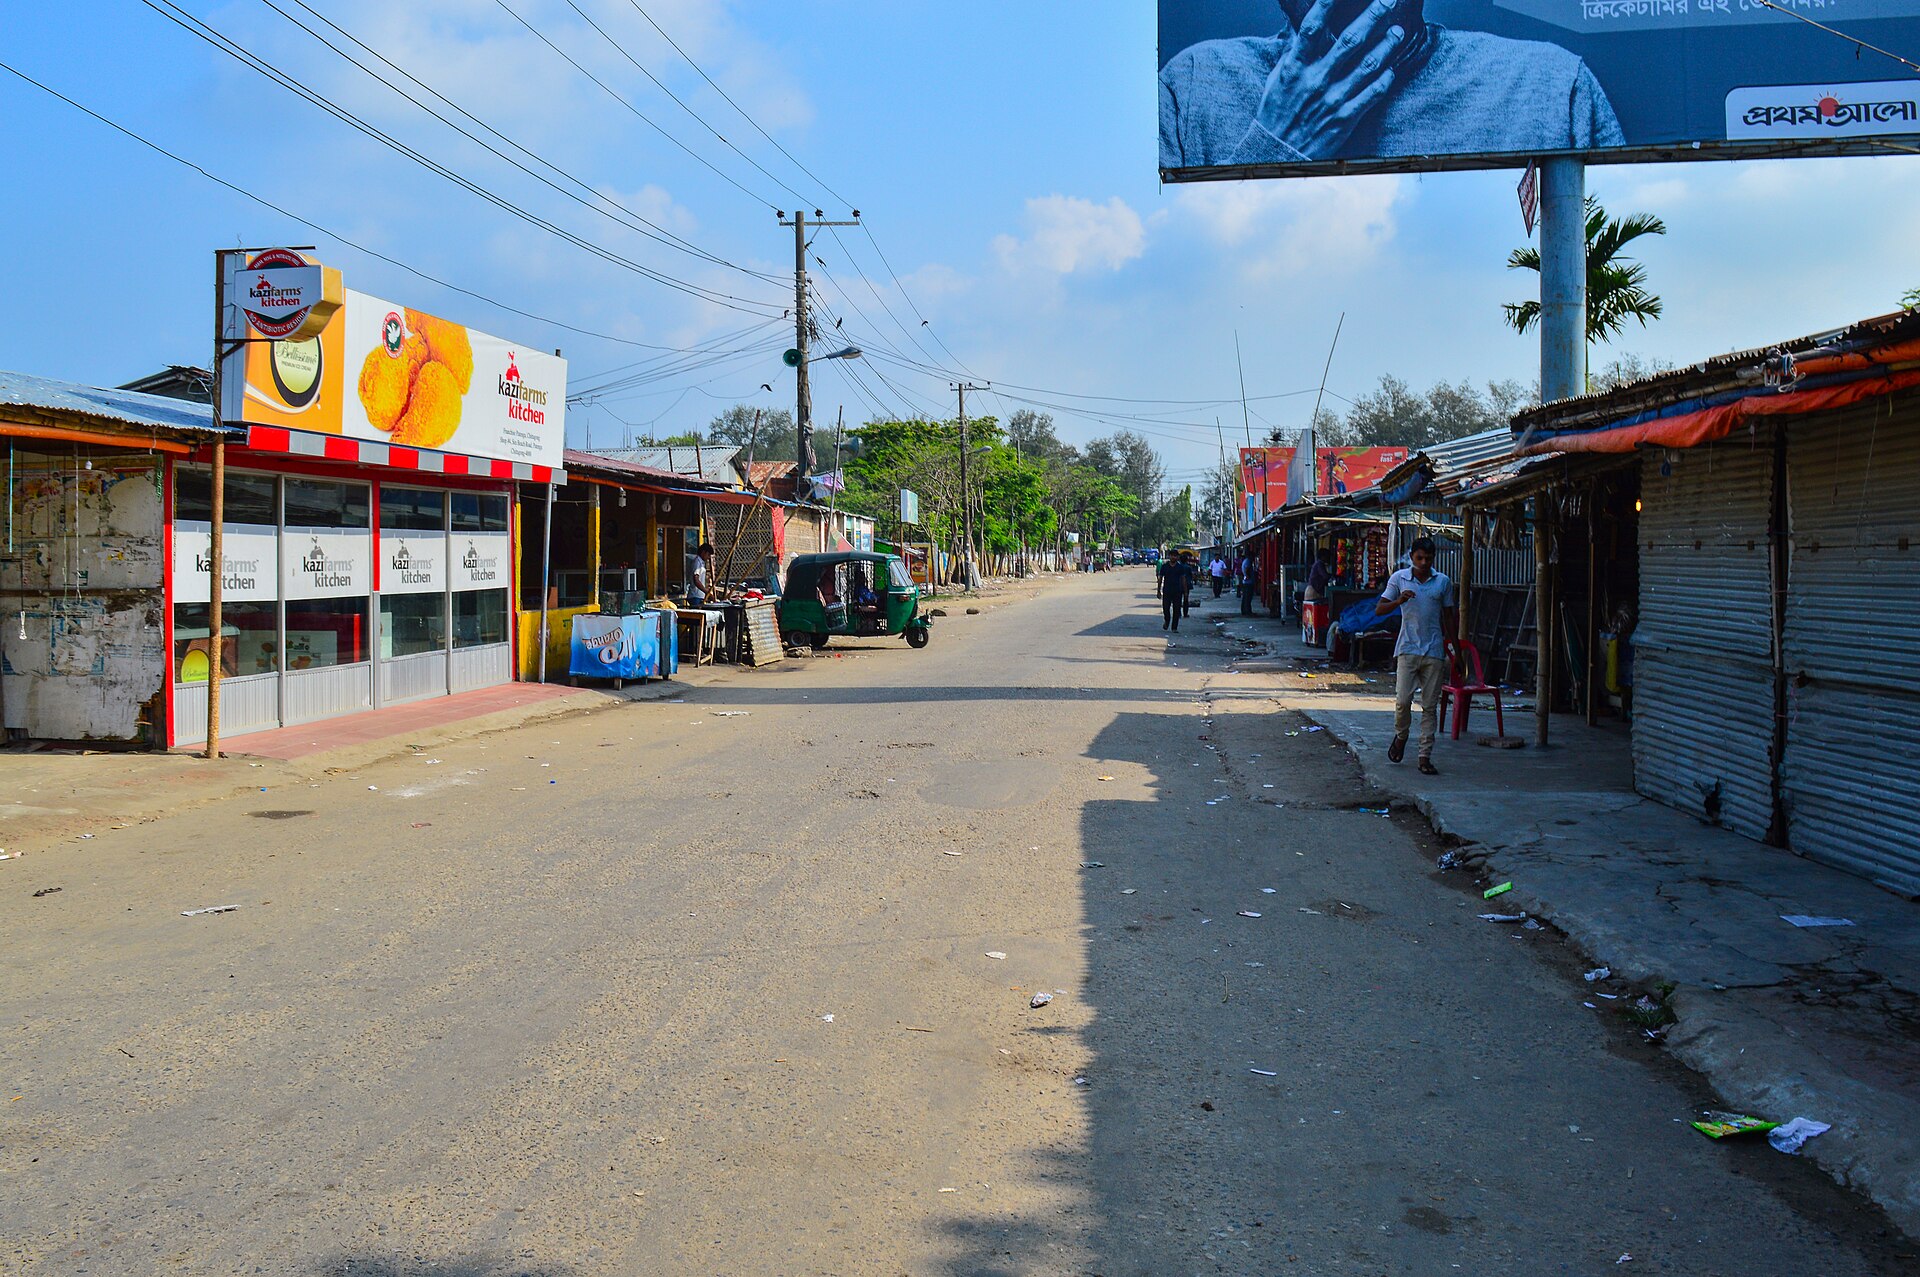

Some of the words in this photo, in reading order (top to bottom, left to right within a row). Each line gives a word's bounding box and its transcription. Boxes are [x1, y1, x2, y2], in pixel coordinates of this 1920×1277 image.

[1743, 106, 1823, 126] প্রথম
[1826, 101, 1917, 127] আলো
[262, 297, 300, 307] kitchen
[256, 321, 286, 333] ANTIBIOTIC
[287, 310, 306, 330] RESIDUE
[509, 398, 545, 425] kitchen
[196, 555, 257, 573] kafarms
[303, 556, 353, 573] kazifarms
[392, 556, 432, 570] kazifarms
[463, 556, 496, 569] kazifarms
[222, 574, 255, 590] tchen
[315, 573, 351, 588] kitchen
[401, 571, 431, 584] kitchen
[471, 568, 495, 581] kitchen
[587, 629, 623, 650] Orange
